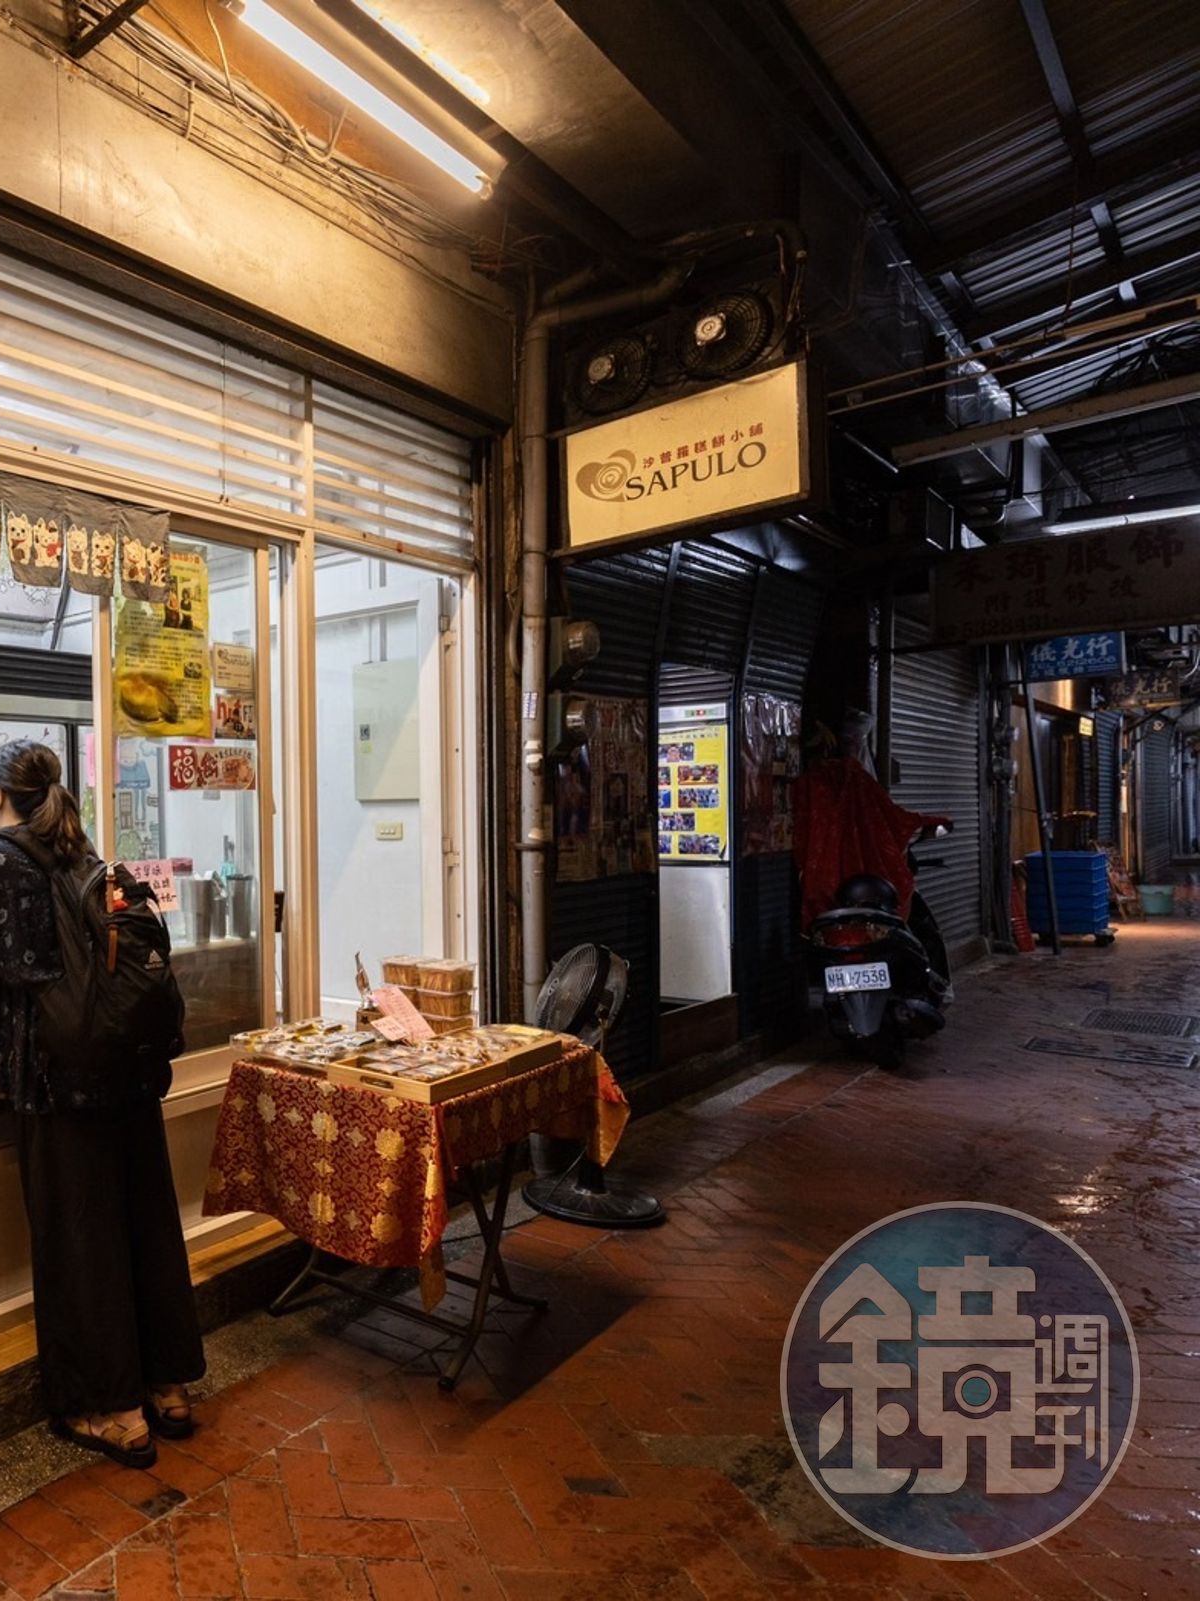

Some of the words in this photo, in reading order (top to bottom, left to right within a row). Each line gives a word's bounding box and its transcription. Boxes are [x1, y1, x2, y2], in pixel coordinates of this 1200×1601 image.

[625, 441, 768, 501] SAPULO
[642, 422, 765, 469] 沙普羅糕餅小舖
